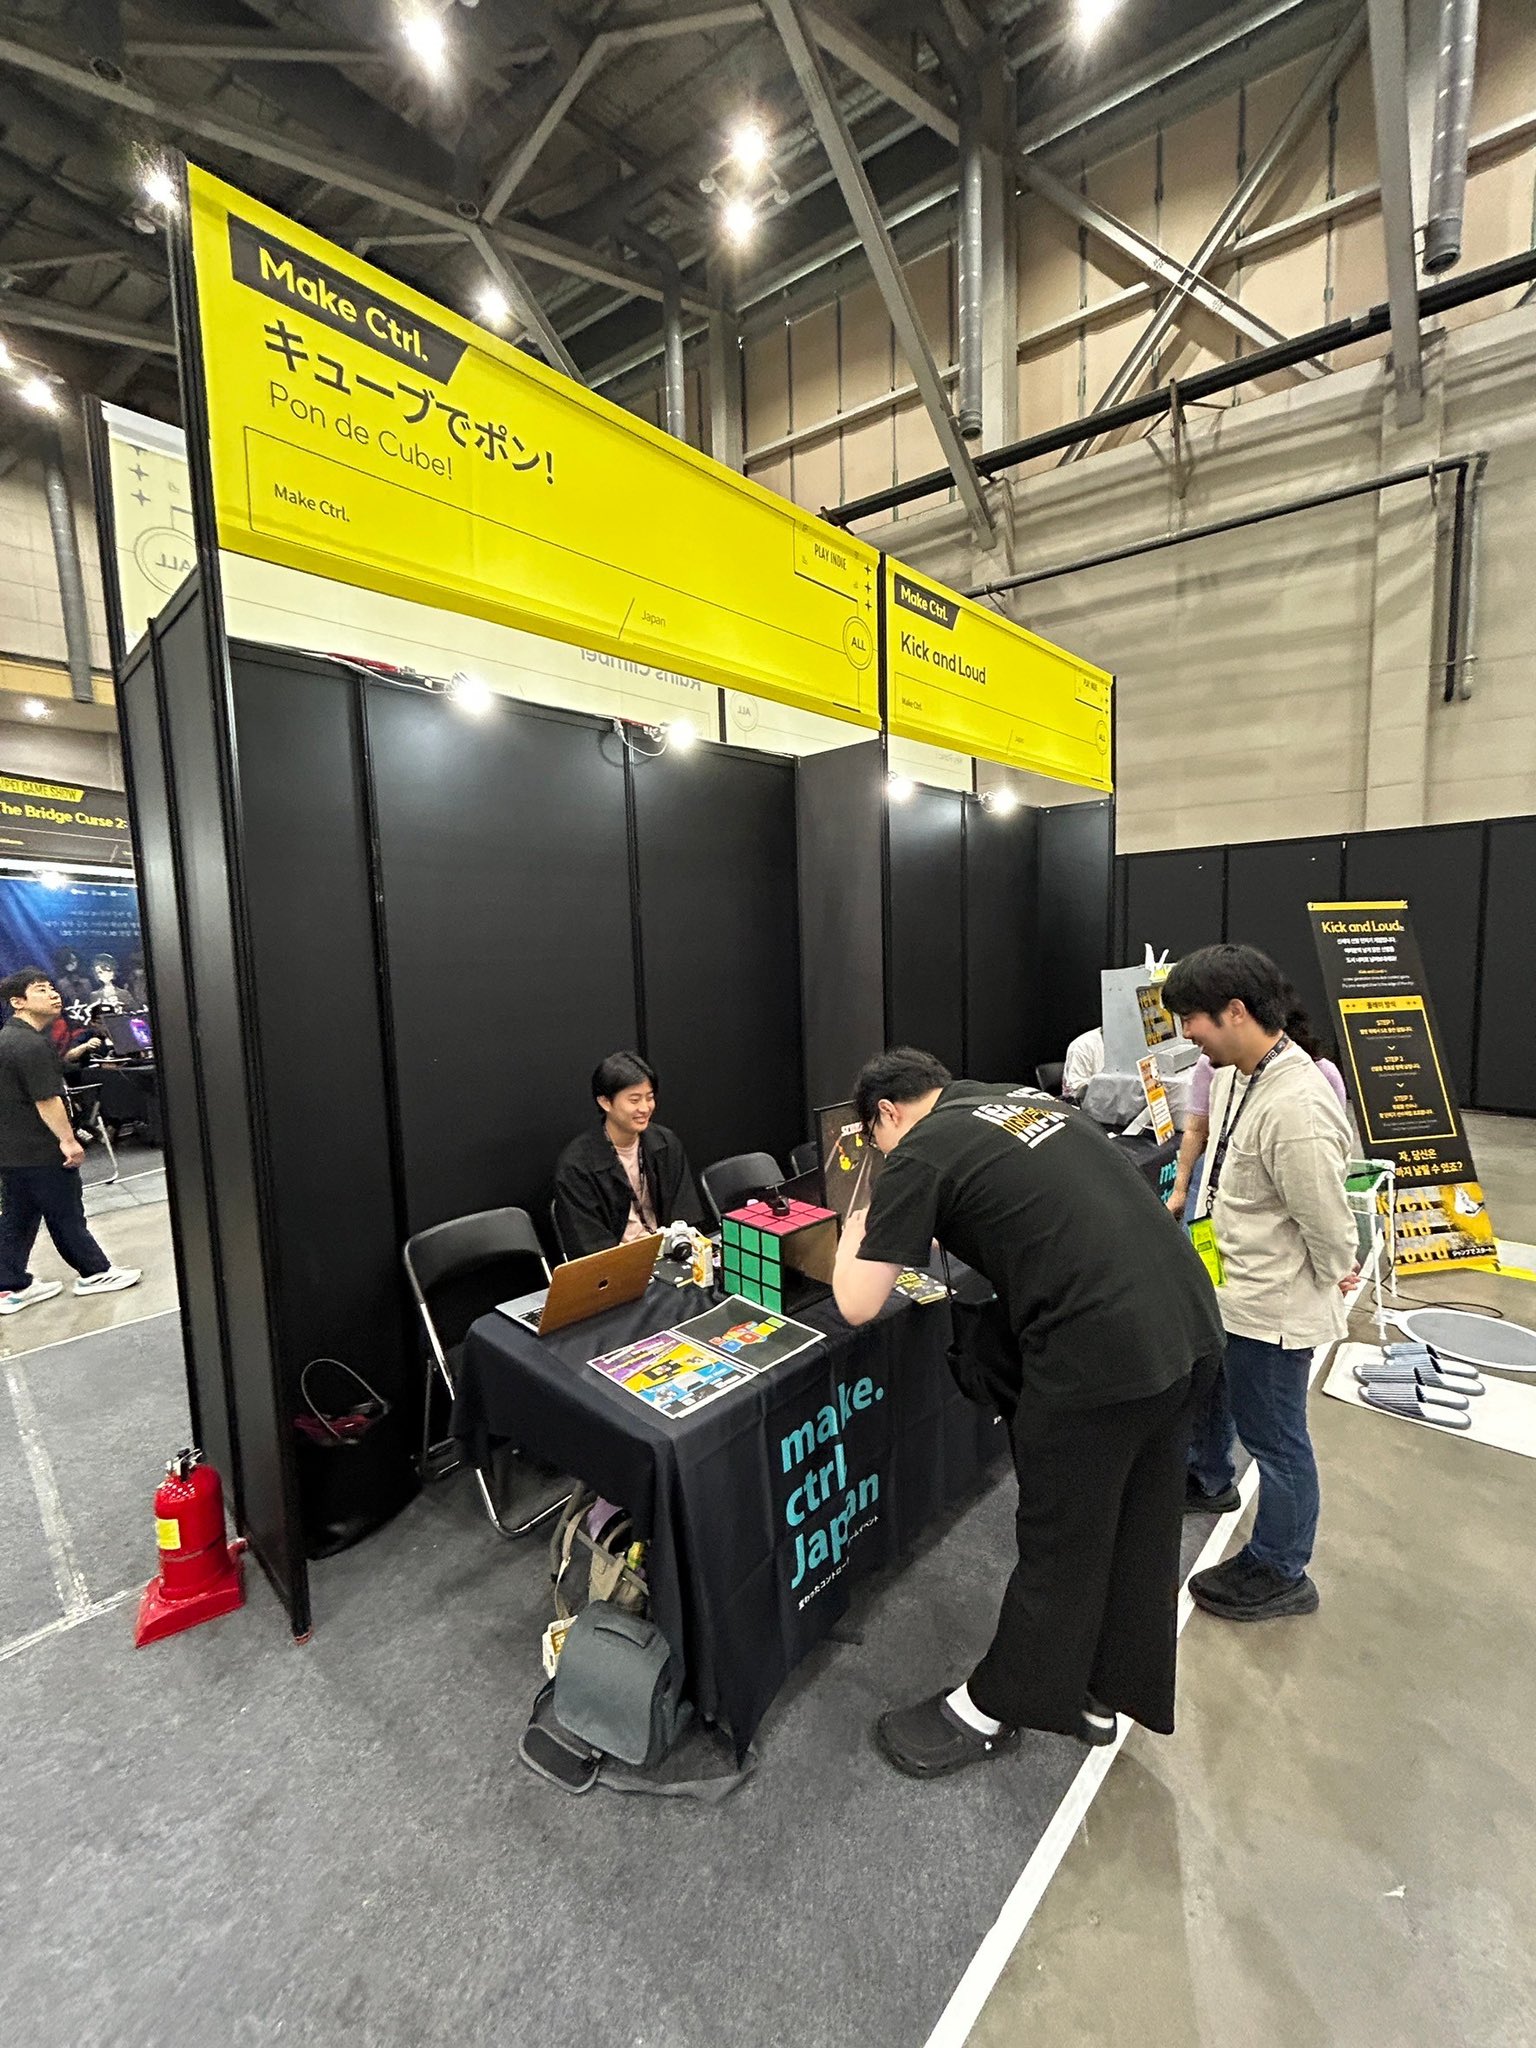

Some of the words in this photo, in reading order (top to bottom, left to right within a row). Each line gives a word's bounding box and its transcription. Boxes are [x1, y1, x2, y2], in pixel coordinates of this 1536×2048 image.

[258, 246, 358, 324] Make
[365, 306, 429, 362] Ctrl.
[264, 318, 554, 485] キューブでポン!
[270, 381, 325, 429] Pon
[335, 414, 370, 446] de
[379, 430, 454, 480] Cube!
[274, 482, 316, 511] Make
[319, 499, 351, 522] Ctrl.
[814, 543, 829, 562] PLAY
[831, 551, 847, 571] INDIE
[641, 610, 666, 627] Japan
[900, 584, 928, 611] Make
[929, 601, 949, 622] Ctrl.
[851, 637, 866, 651] ALL
[900, 631, 930, 663] Kick
[933, 649, 956, 673] and
[959, 656, 986, 685] Loud
[24, 804, 73, 824] Bridge
[75, 812, 114, 828] Curse
[1321, 921, 1348, 933] Kick
[1348, 920, 1372, 933] and
[780, 1376, 884, 1474] make.
[785, 1443, 848, 1527] ctrl
[791, 1473, 879, 1590] Japan
